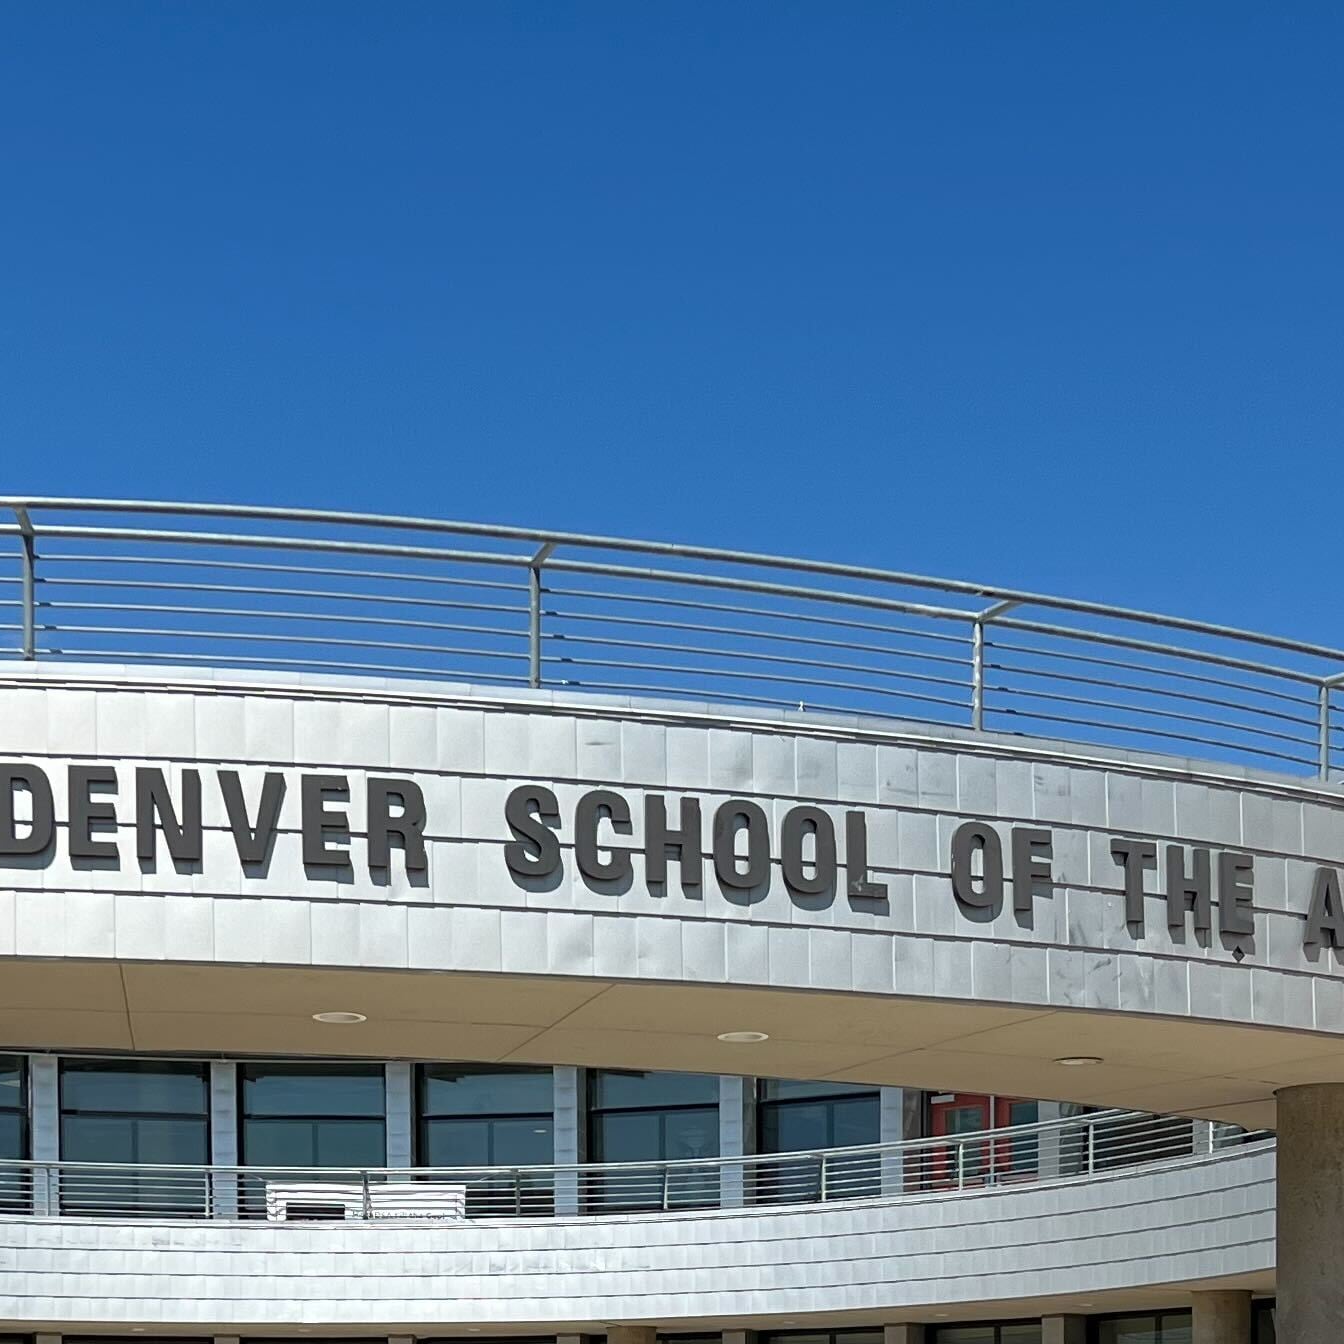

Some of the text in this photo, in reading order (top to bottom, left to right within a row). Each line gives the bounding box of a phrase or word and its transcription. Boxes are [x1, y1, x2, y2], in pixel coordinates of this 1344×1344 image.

[505, 785, 888, 899] SCHOOL
[953, 821, 1052, 910] OF
[1111, 838, 1254, 936] THE
